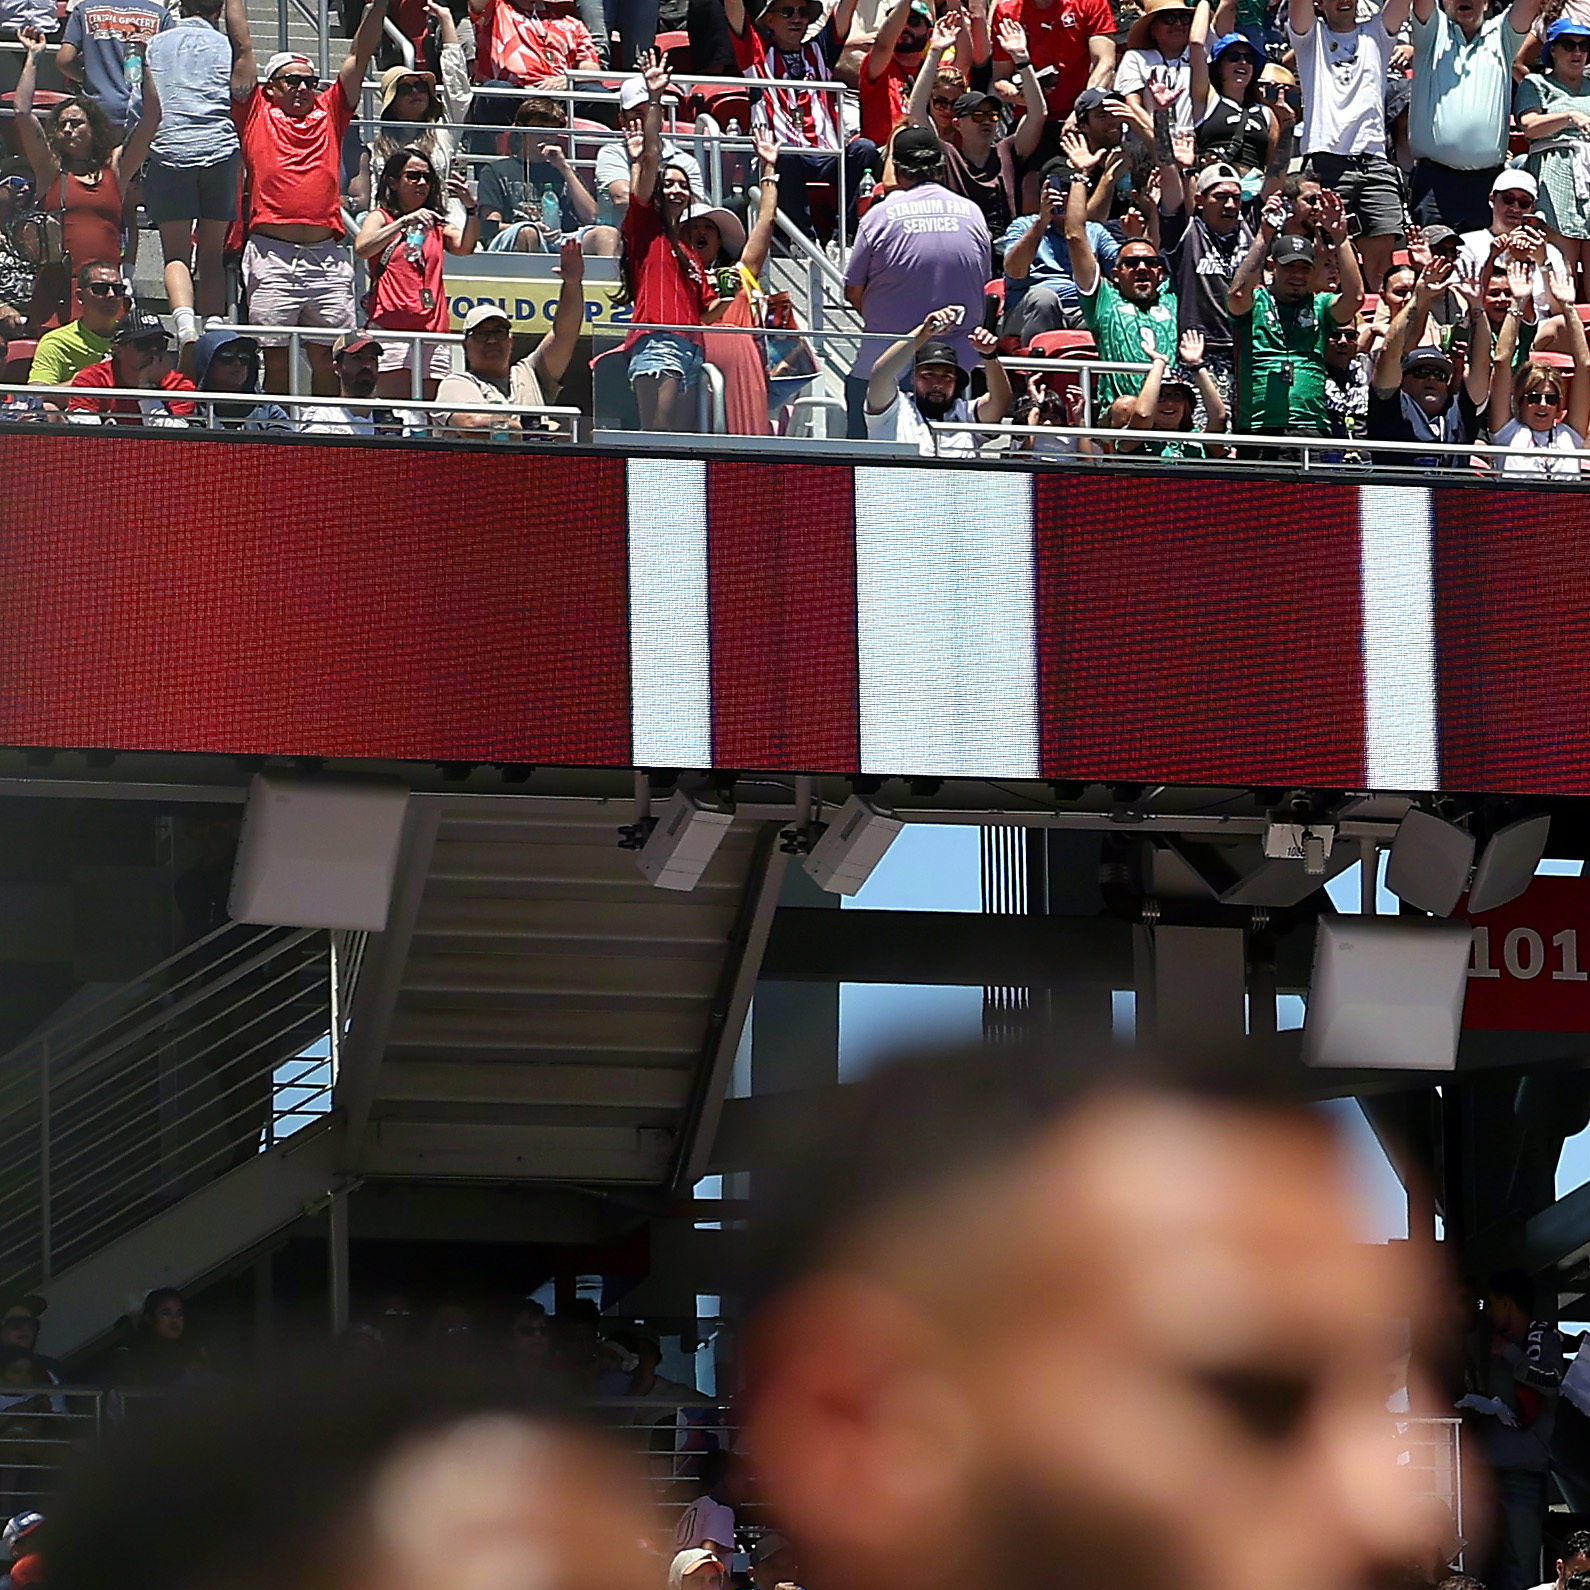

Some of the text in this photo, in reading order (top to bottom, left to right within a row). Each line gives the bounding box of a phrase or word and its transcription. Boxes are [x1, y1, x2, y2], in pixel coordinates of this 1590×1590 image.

[89, 14, 156, 28] CENTRAL GROCERY
[887, 198, 972, 221] STADIUM FAN
[903, 217, 961, 234] SERVICES
[543, 299, 603, 323] CP
[1466, 927, 1588, 980] 101
